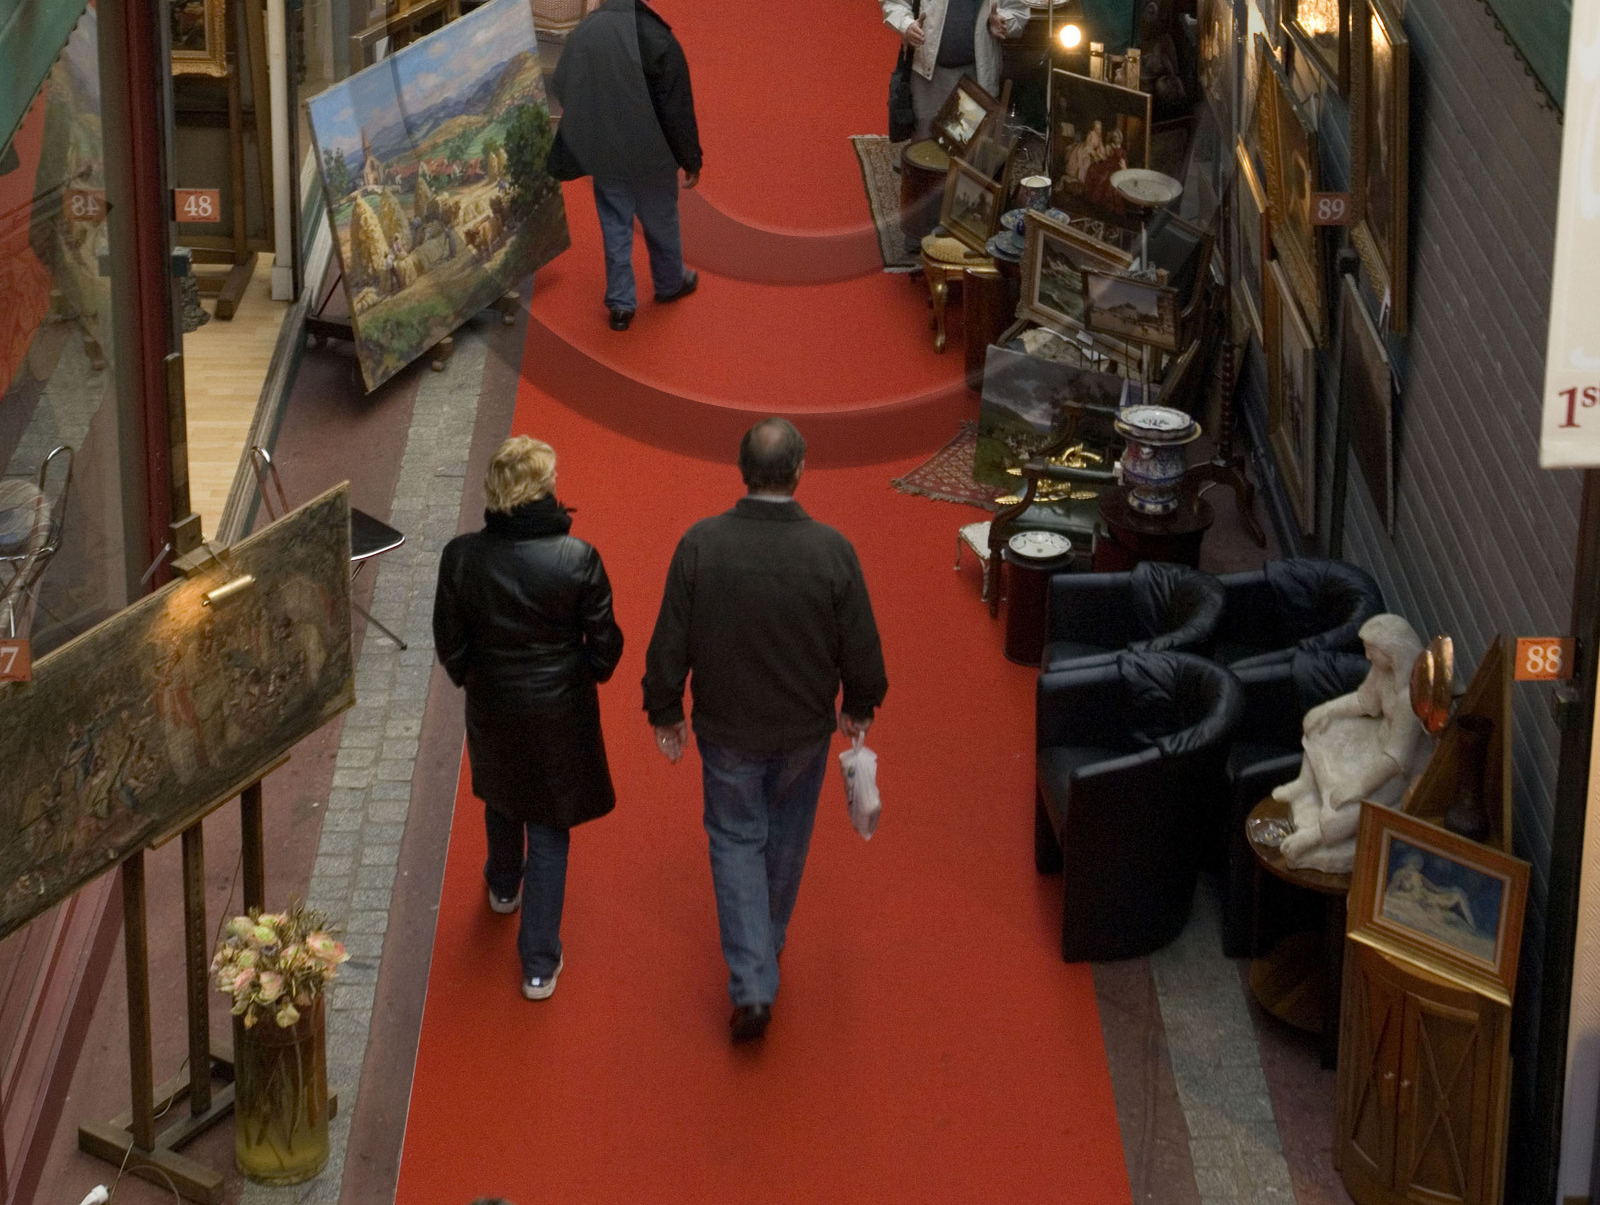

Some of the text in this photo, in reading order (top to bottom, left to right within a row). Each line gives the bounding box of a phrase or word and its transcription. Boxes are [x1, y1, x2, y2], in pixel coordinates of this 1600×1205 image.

[183, 195, 213, 217] 48
[1317, 199, 1345, 219] 89
[1557, 385, 1600, 429] 1s
[0, 646, 19, 674] 7
[1526, 645, 1562, 673] 88
